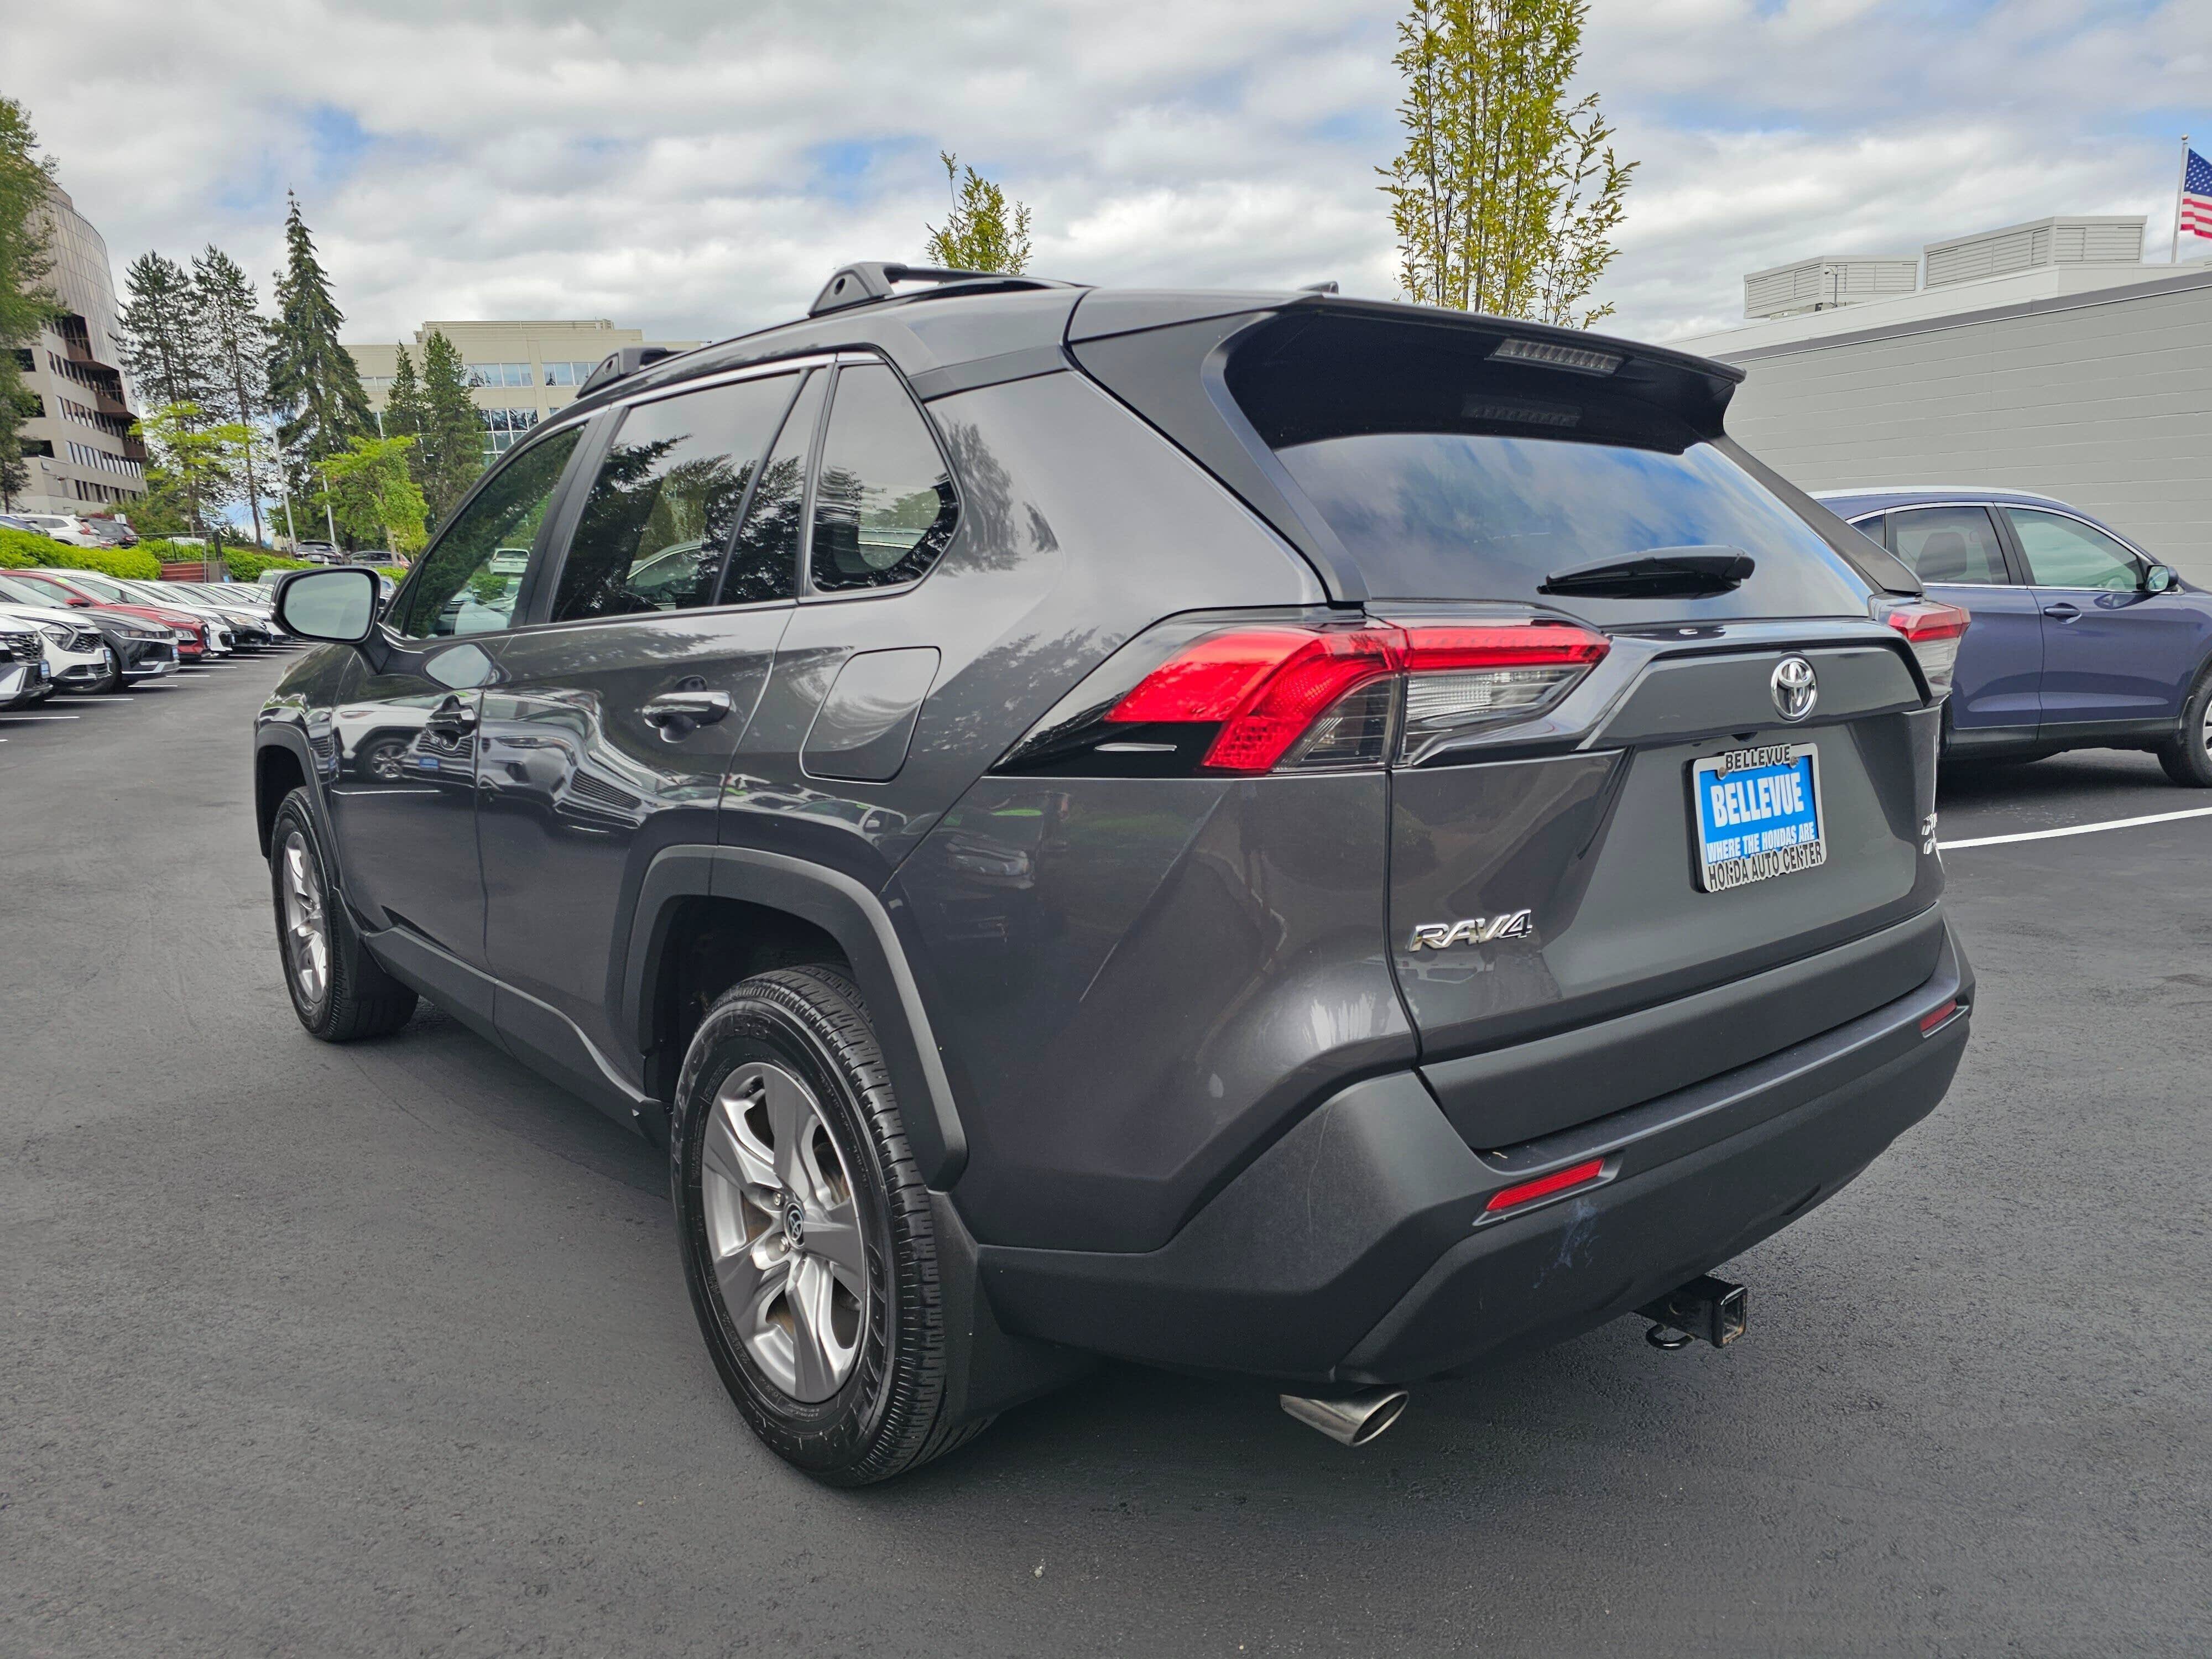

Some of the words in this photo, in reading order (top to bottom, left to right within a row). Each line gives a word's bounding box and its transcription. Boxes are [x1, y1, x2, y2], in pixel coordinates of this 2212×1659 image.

[1725, 745, 1791, 771] BELLEVUE
[1710, 772, 1804, 827] BELLEVUE
[1707, 837, 1741, 863] WHERE
[1743, 832, 1760, 854] THE
[1761, 825, 1797, 850] HONDAS
[1798, 821, 1815, 844] ARE
[1708, 860, 1750, 890] HONDA
[1752, 851, 1779, 881] AUTO
[1783, 841, 1823, 869] CENTER
[1408, 909, 1533, 952] RAV4
